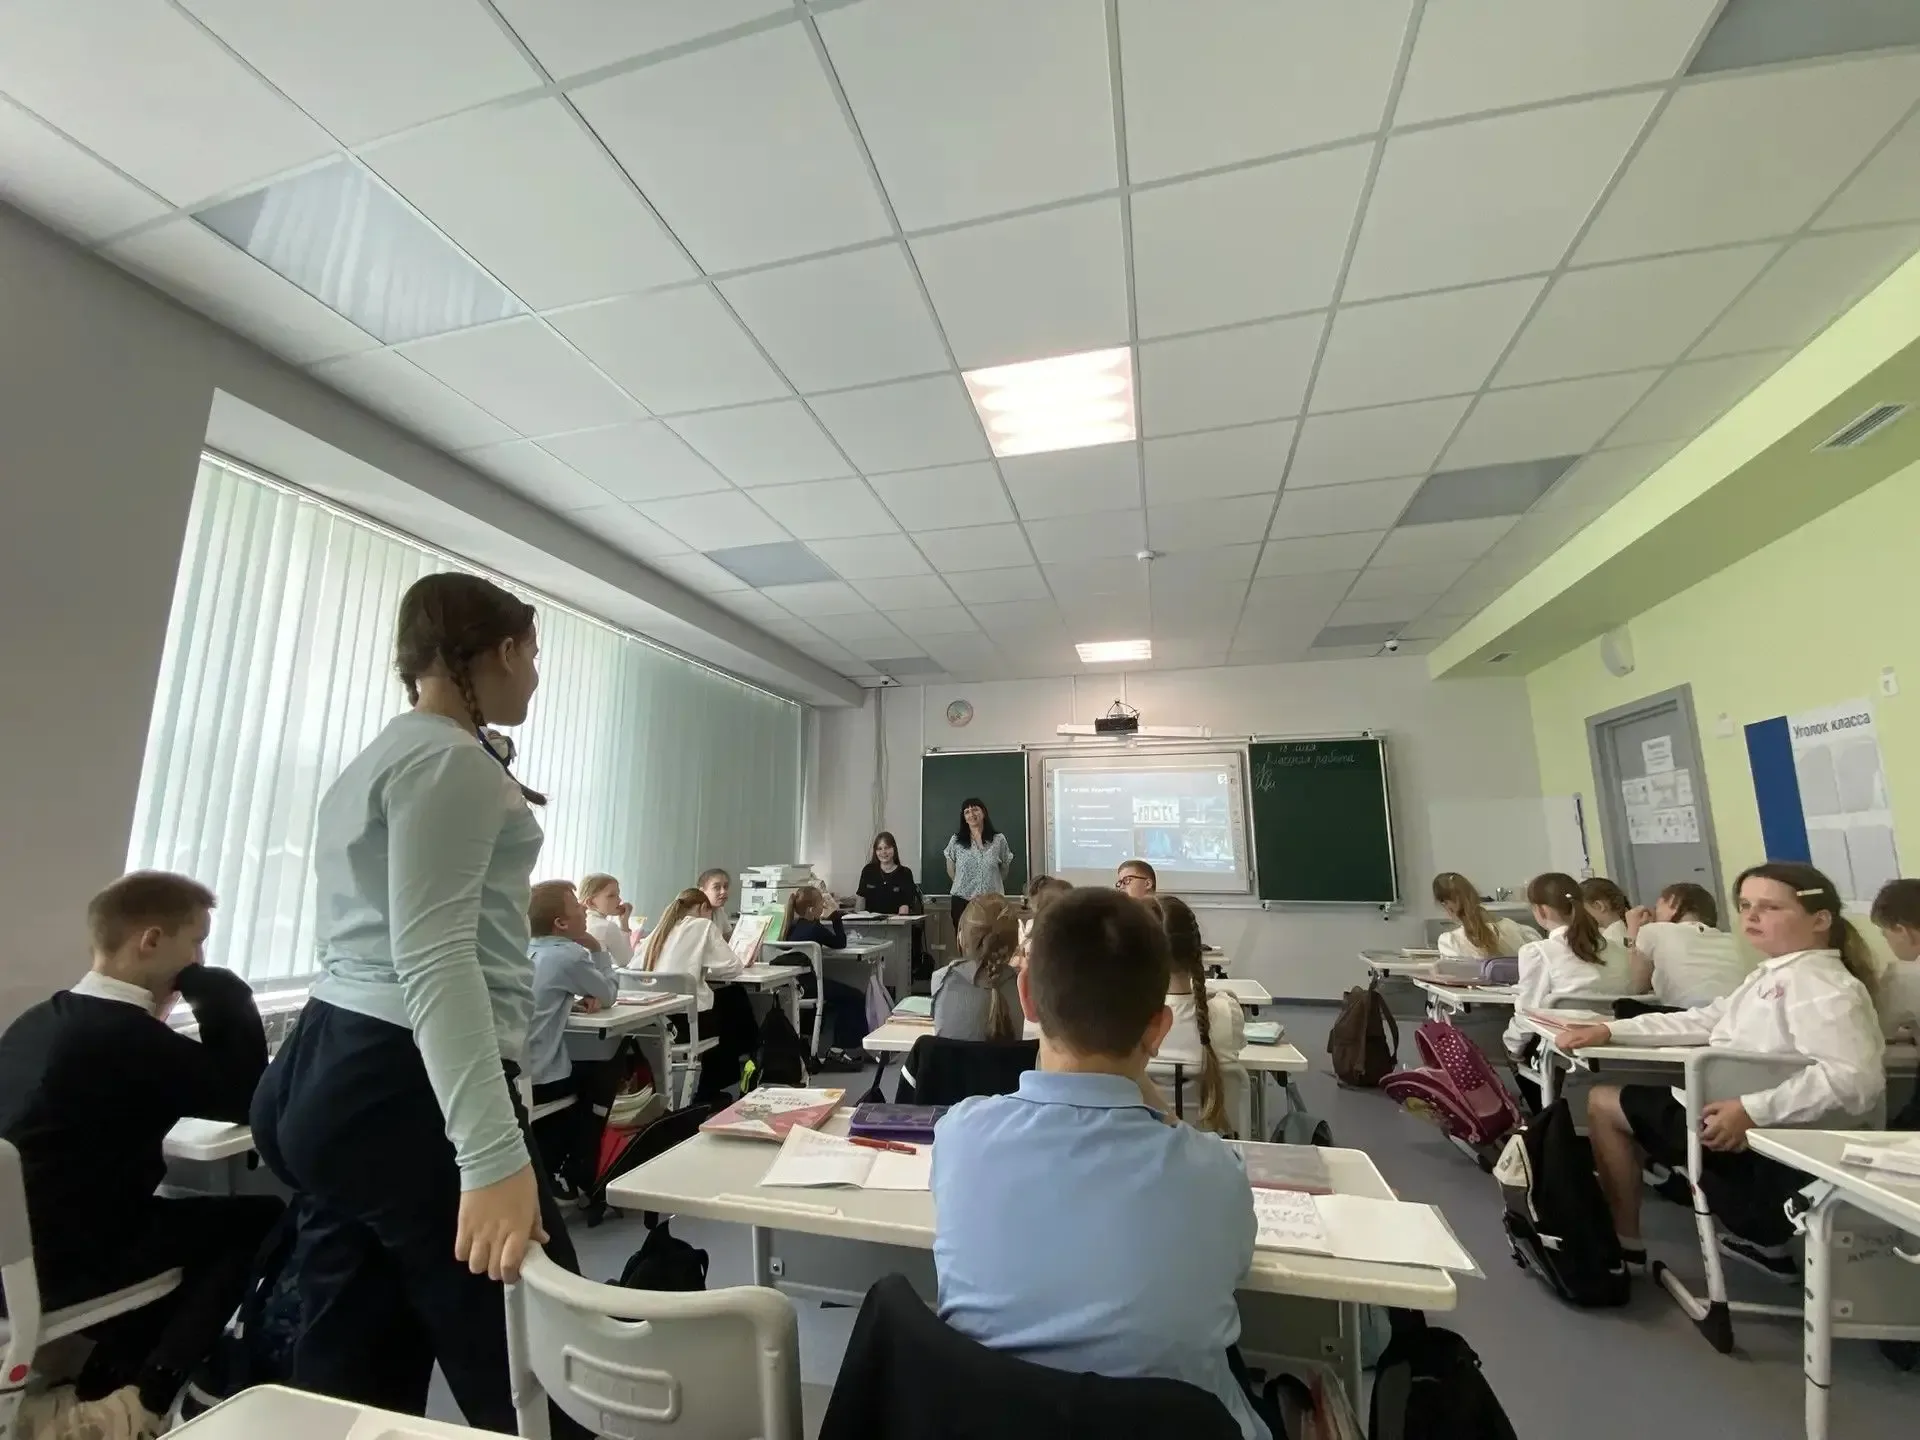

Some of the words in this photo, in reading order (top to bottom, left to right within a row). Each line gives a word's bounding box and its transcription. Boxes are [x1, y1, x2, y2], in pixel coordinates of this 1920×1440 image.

[1793, 722, 1829, 739] Уголок
[1830, 712, 1871, 731] класса
[1313, 749, 1356, 768] работа
